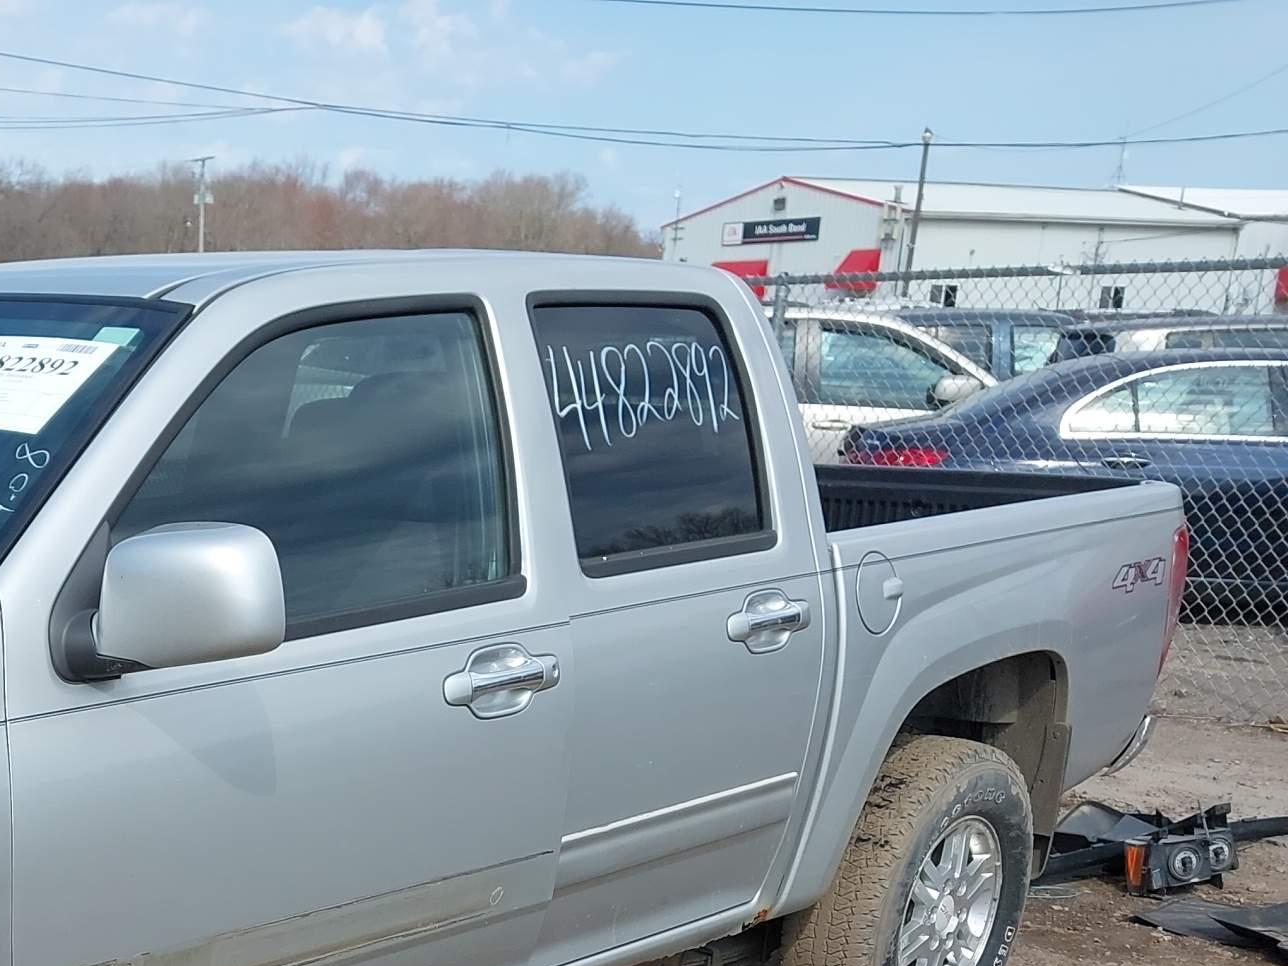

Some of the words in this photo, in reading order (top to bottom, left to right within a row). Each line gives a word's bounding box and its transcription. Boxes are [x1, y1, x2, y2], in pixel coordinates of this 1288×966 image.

[769, 224, 787, 234] South
[788, 222, 807, 233] Bend
[545, 341, 740, 451] 44822892
